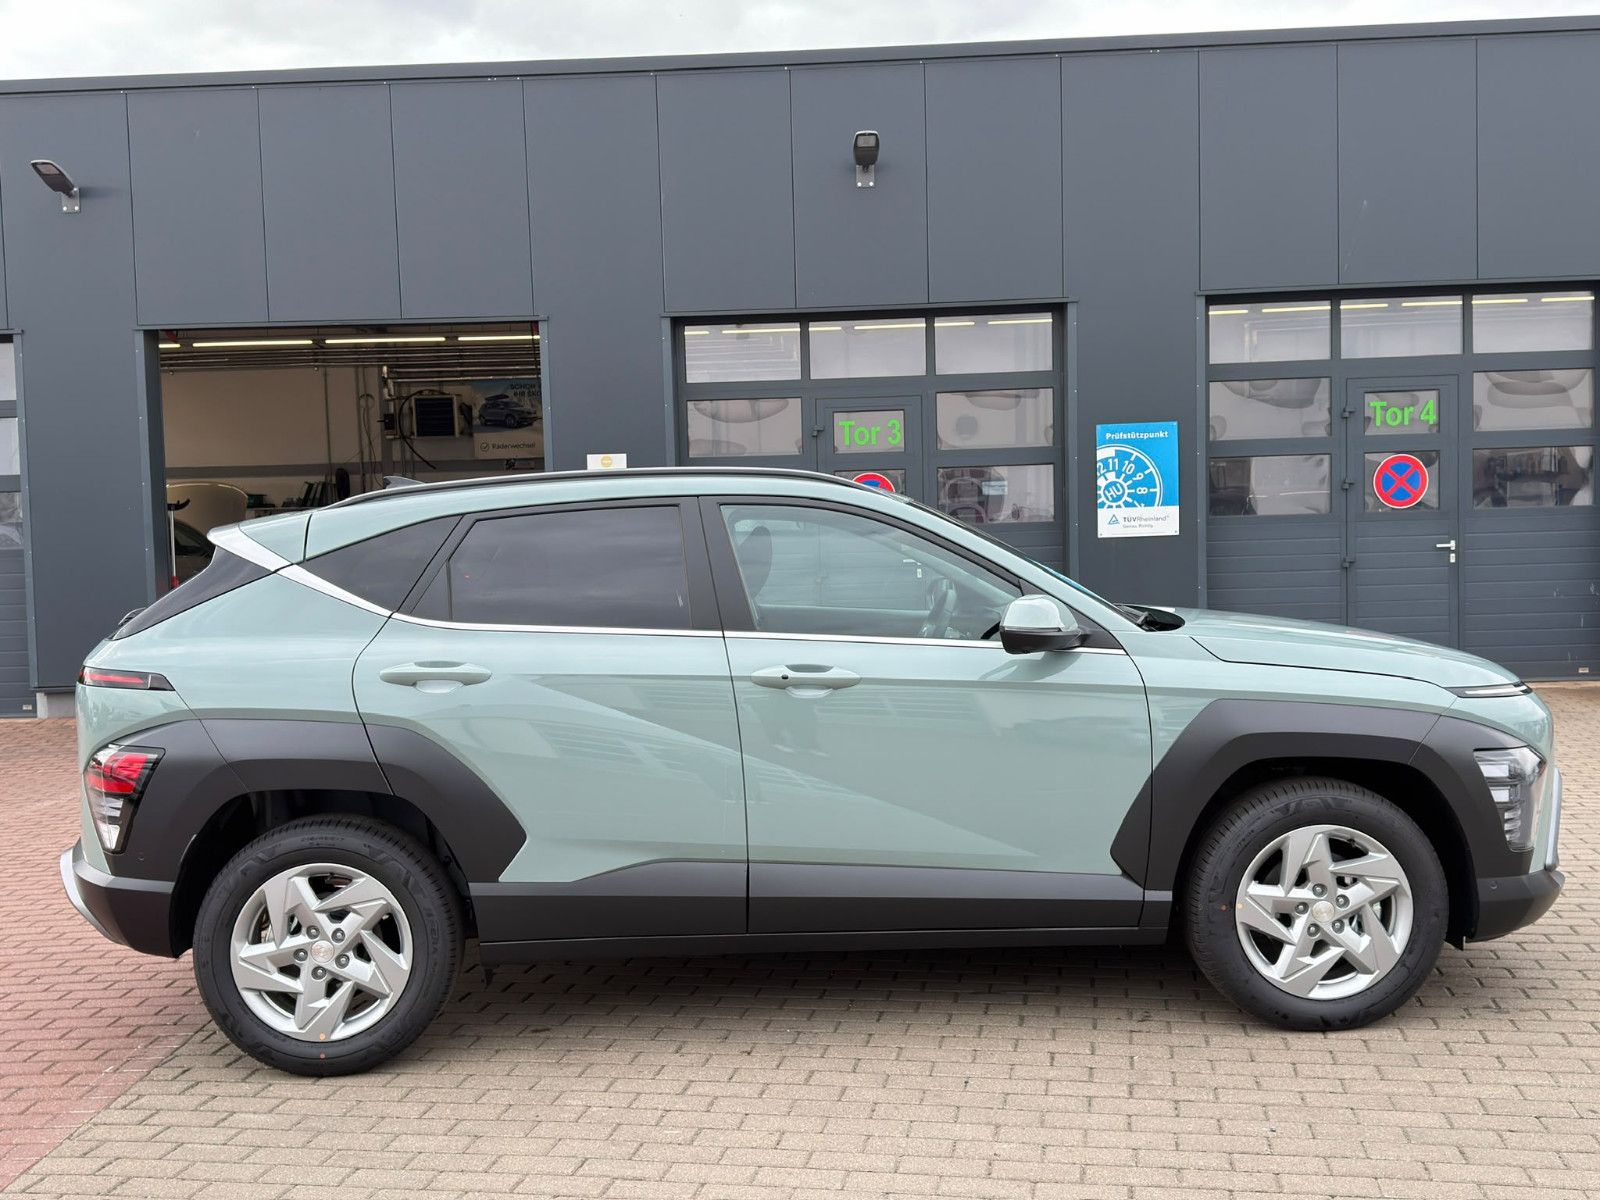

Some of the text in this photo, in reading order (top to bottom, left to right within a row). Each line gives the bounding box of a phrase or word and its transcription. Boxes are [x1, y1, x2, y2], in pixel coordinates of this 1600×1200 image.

[1369, 400, 1436, 426] Tor 4
[839, 418, 901, 446] Tor 3
[1105, 431, 1169, 440] Prüfstützpunkt
[1108, 459, 1119, 470] 11
[1122, 460, 1135, 475] 10
[1132, 472, 1144, 481] 9
[1104, 483, 1123, 501] HU
[1136, 487, 1148, 495] 8
